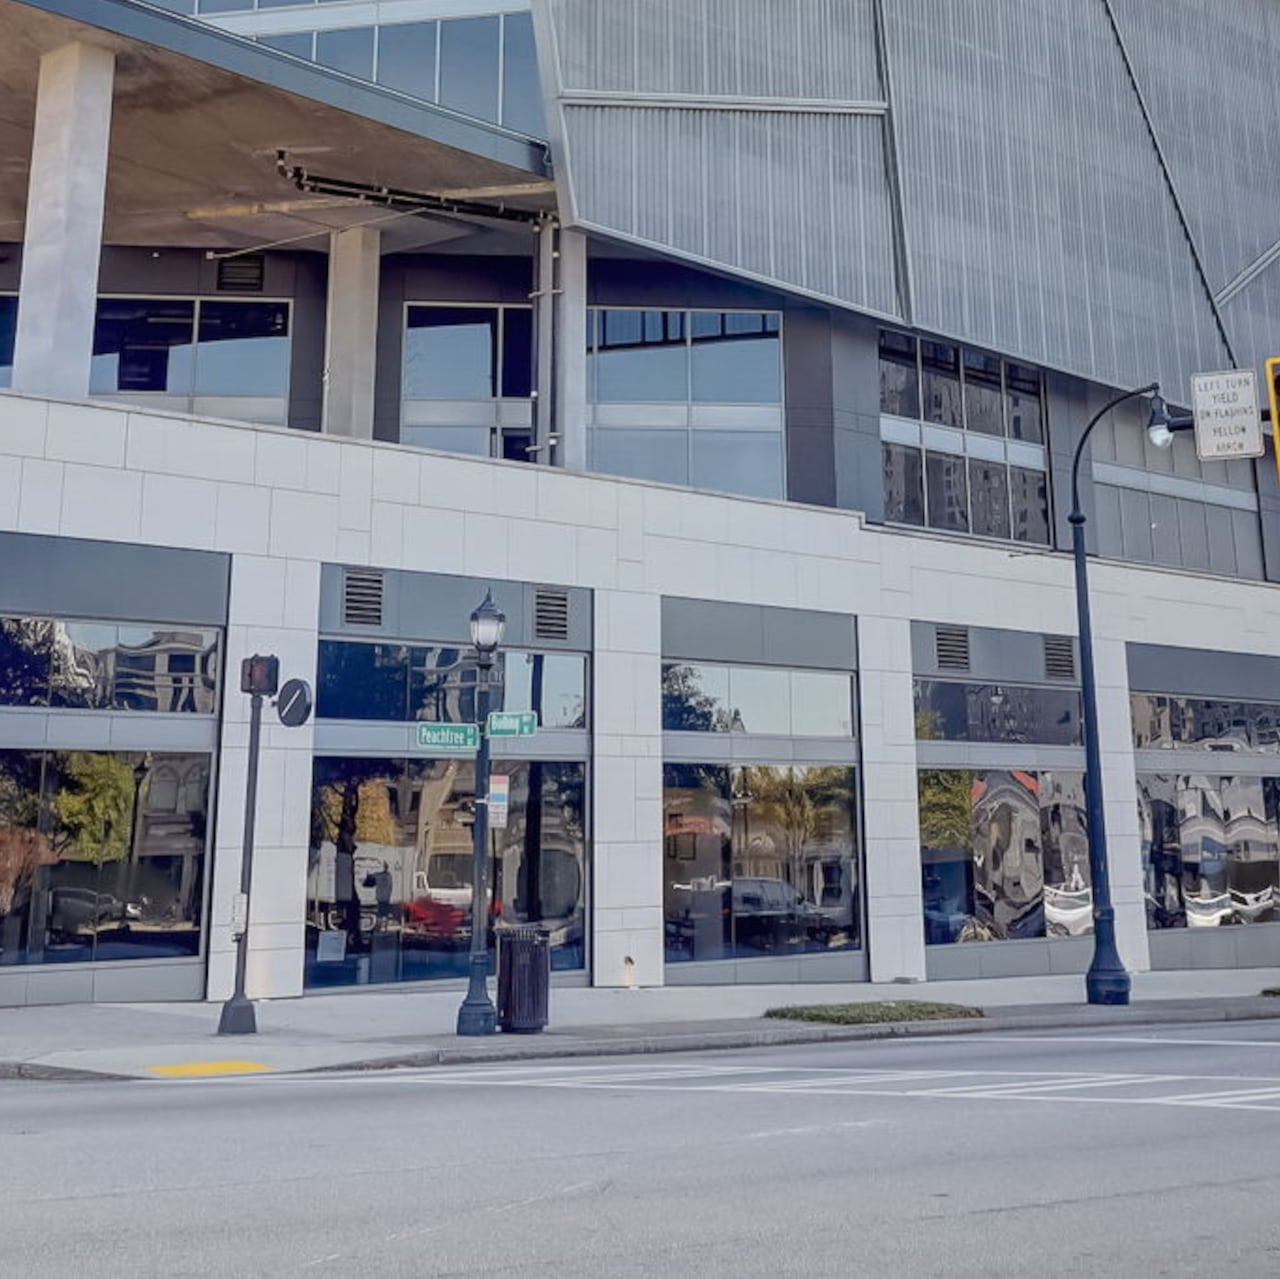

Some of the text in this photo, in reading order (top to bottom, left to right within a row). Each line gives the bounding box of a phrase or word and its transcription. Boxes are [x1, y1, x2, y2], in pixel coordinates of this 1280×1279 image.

[1198, 378, 1250, 393] LEFT TURN
[422, 726, 465, 745] Peachtree
